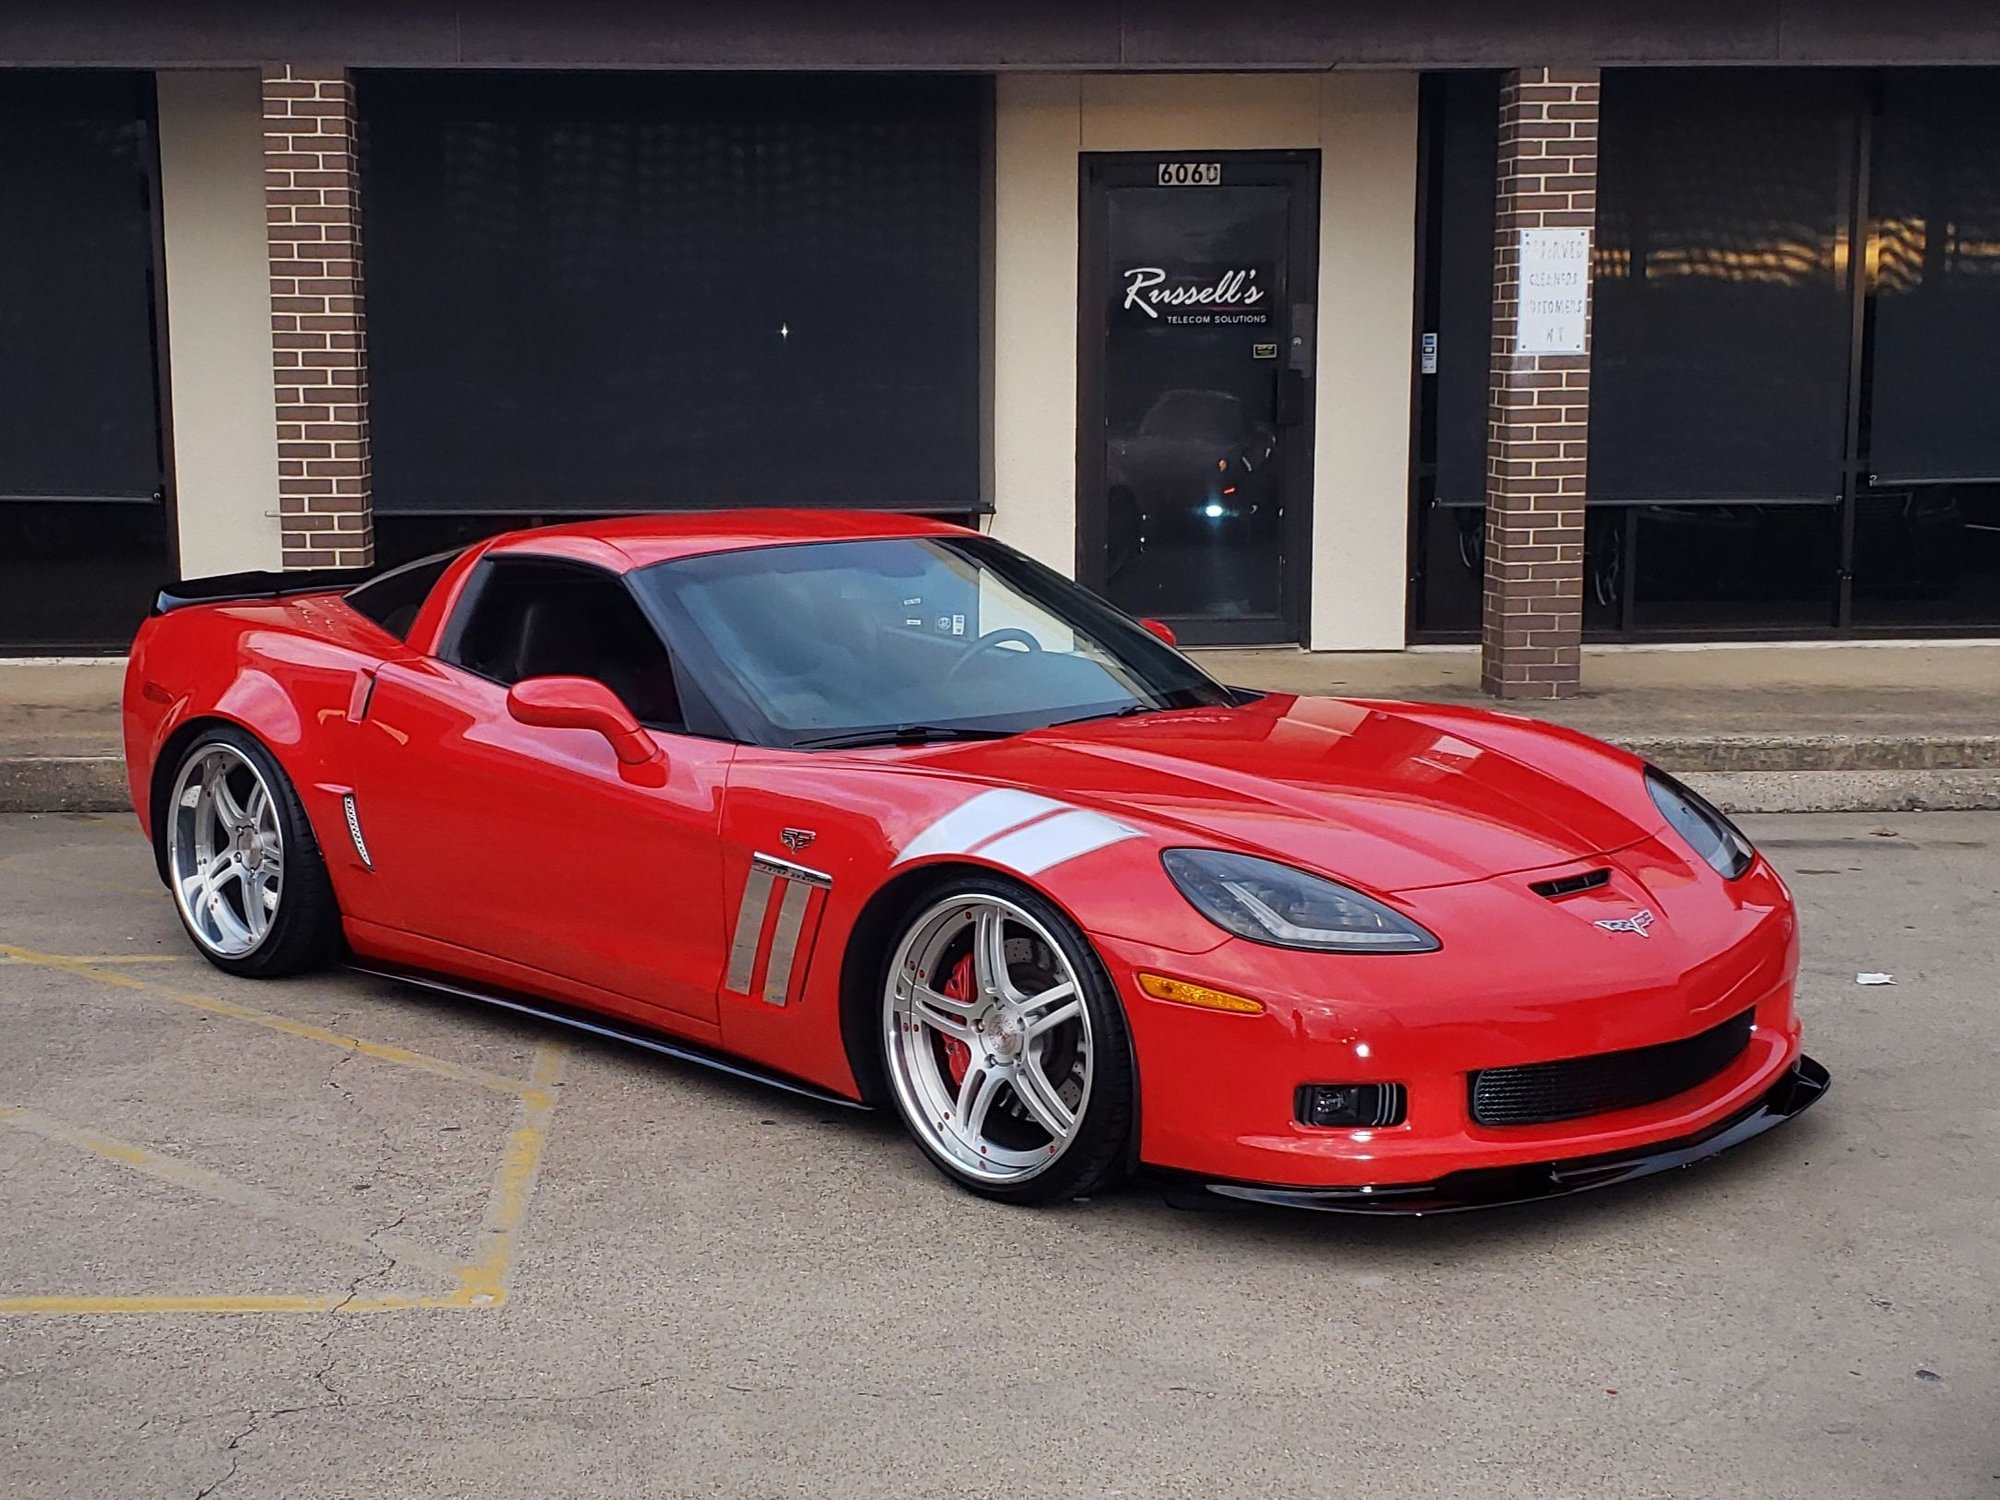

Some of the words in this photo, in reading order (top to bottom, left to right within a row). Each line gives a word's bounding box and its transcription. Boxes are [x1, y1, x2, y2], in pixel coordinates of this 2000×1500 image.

[1123, 267, 1265, 319] Russell's
[1167, 315, 1211, 324] TELECOM
[1214, 314, 1267, 324] SOLUTIONS
